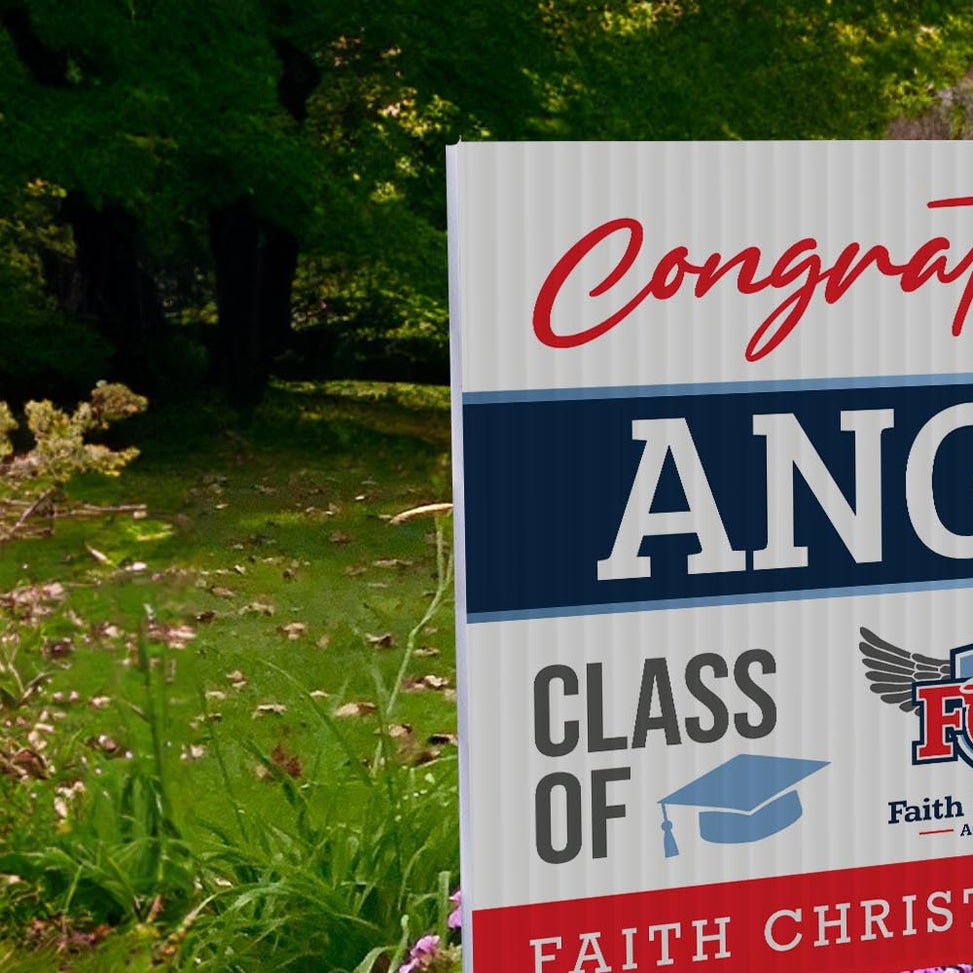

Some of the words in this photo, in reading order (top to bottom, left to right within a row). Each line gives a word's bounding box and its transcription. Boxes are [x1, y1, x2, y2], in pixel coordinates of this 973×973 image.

[533, 649, 777, 758] CLASS
[534, 767, 631, 864] OF
[888, 796, 964, 825] Faith
